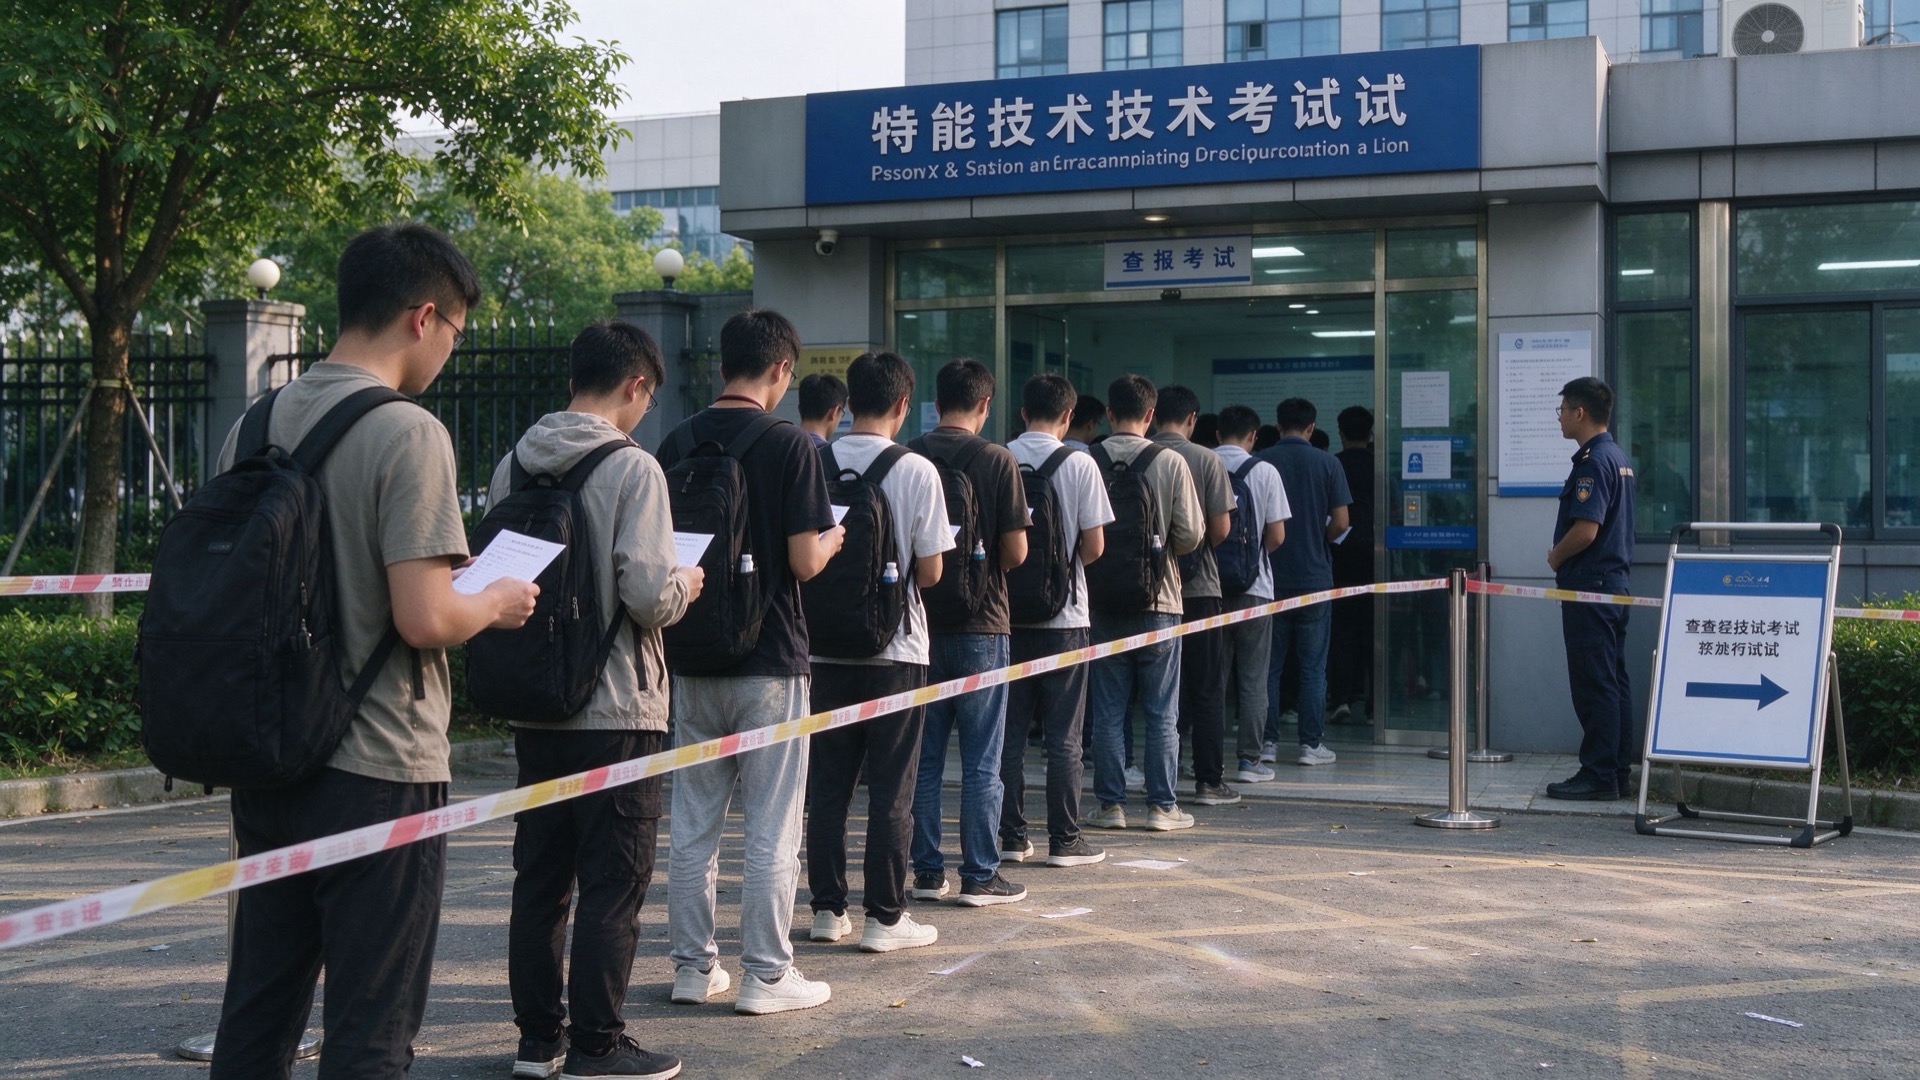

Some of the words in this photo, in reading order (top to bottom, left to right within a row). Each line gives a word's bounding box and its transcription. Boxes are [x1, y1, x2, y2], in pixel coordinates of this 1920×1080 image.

[870, 73, 1408, 156] 特能技术技术考试试
[945, 162, 958, 178] &
[1030, 160, 1050, 173] an
[1357, 144, 1367, 155] a
[1373, 138, 1409, 154] Lion
[1122, 245, 1235, 273] 查报考试
